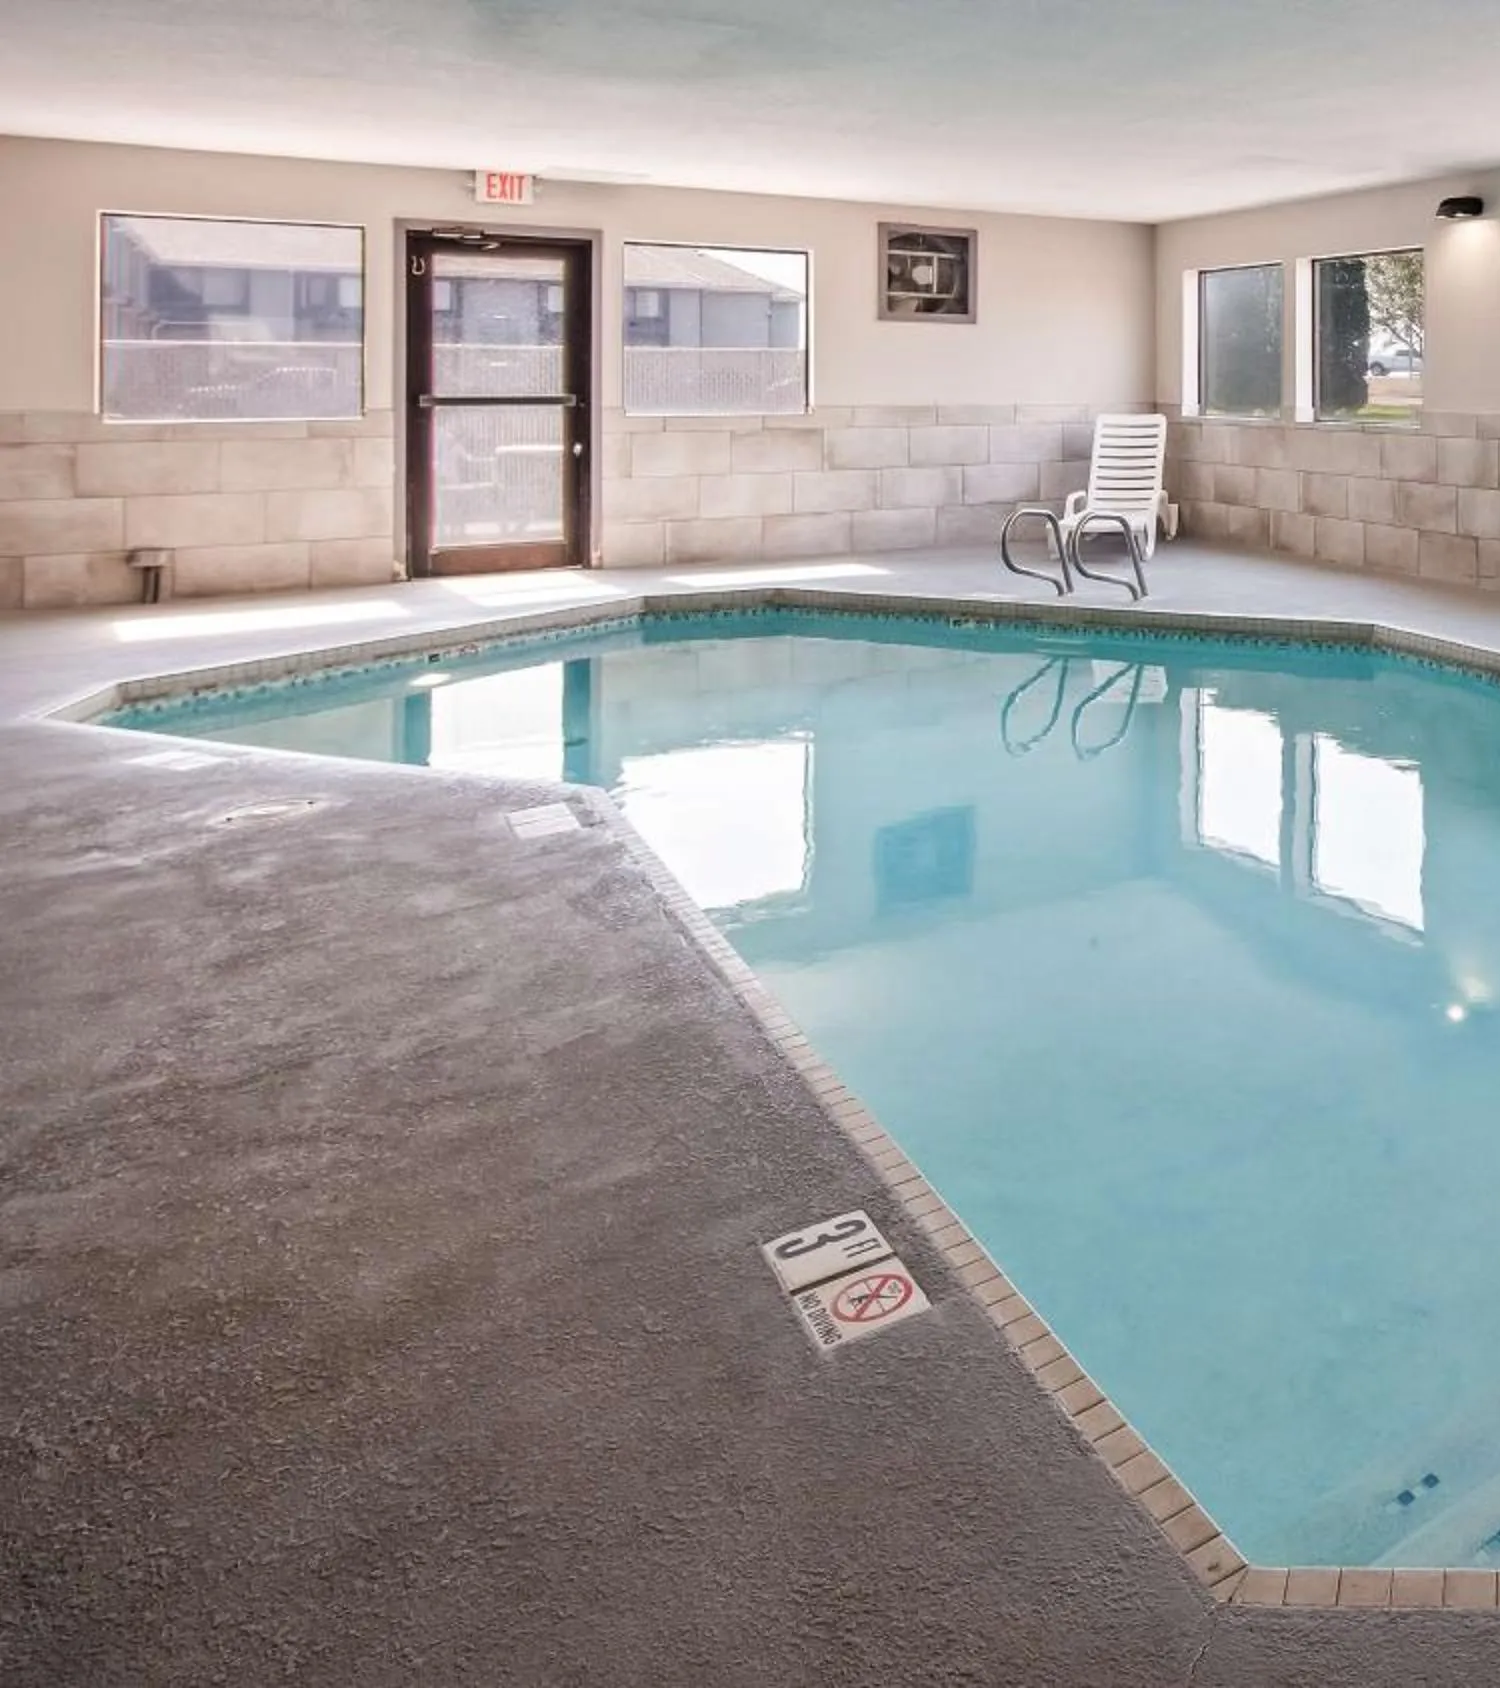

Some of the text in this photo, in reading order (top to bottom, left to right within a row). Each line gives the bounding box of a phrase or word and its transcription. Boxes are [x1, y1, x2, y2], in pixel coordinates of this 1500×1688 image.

[486, 172, 526, 200] EXIT
[774, 1219, 882, 1260] 3 FT
[798, 1290, 843, 1346] NO DIVING
